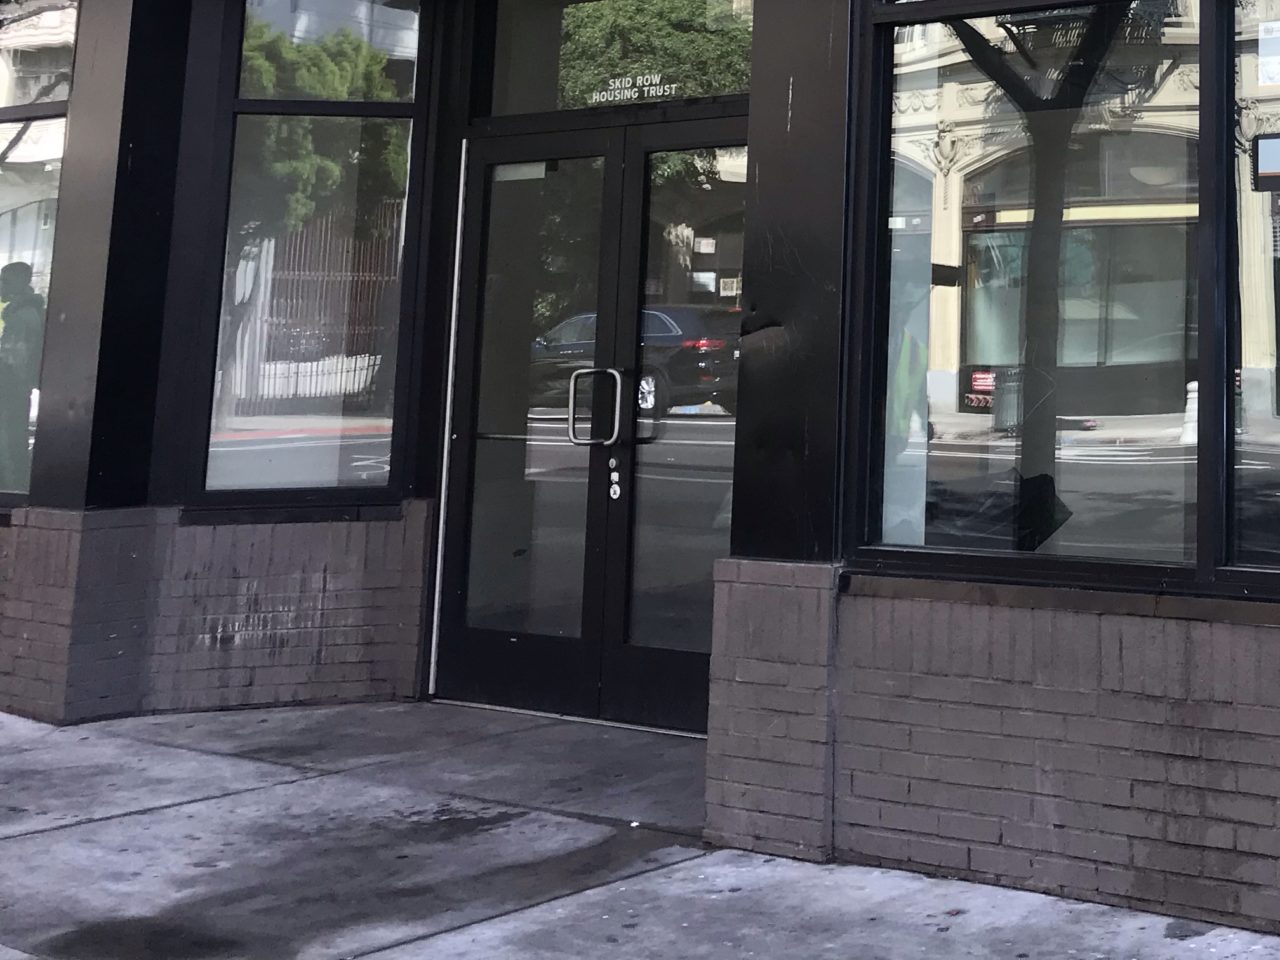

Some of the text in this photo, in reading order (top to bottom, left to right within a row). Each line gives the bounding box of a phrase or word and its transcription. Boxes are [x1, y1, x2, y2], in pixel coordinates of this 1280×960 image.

[608, 73, 662, 90] SKID ROW
[592, 83, 678, 103] HOUSING TRUST
